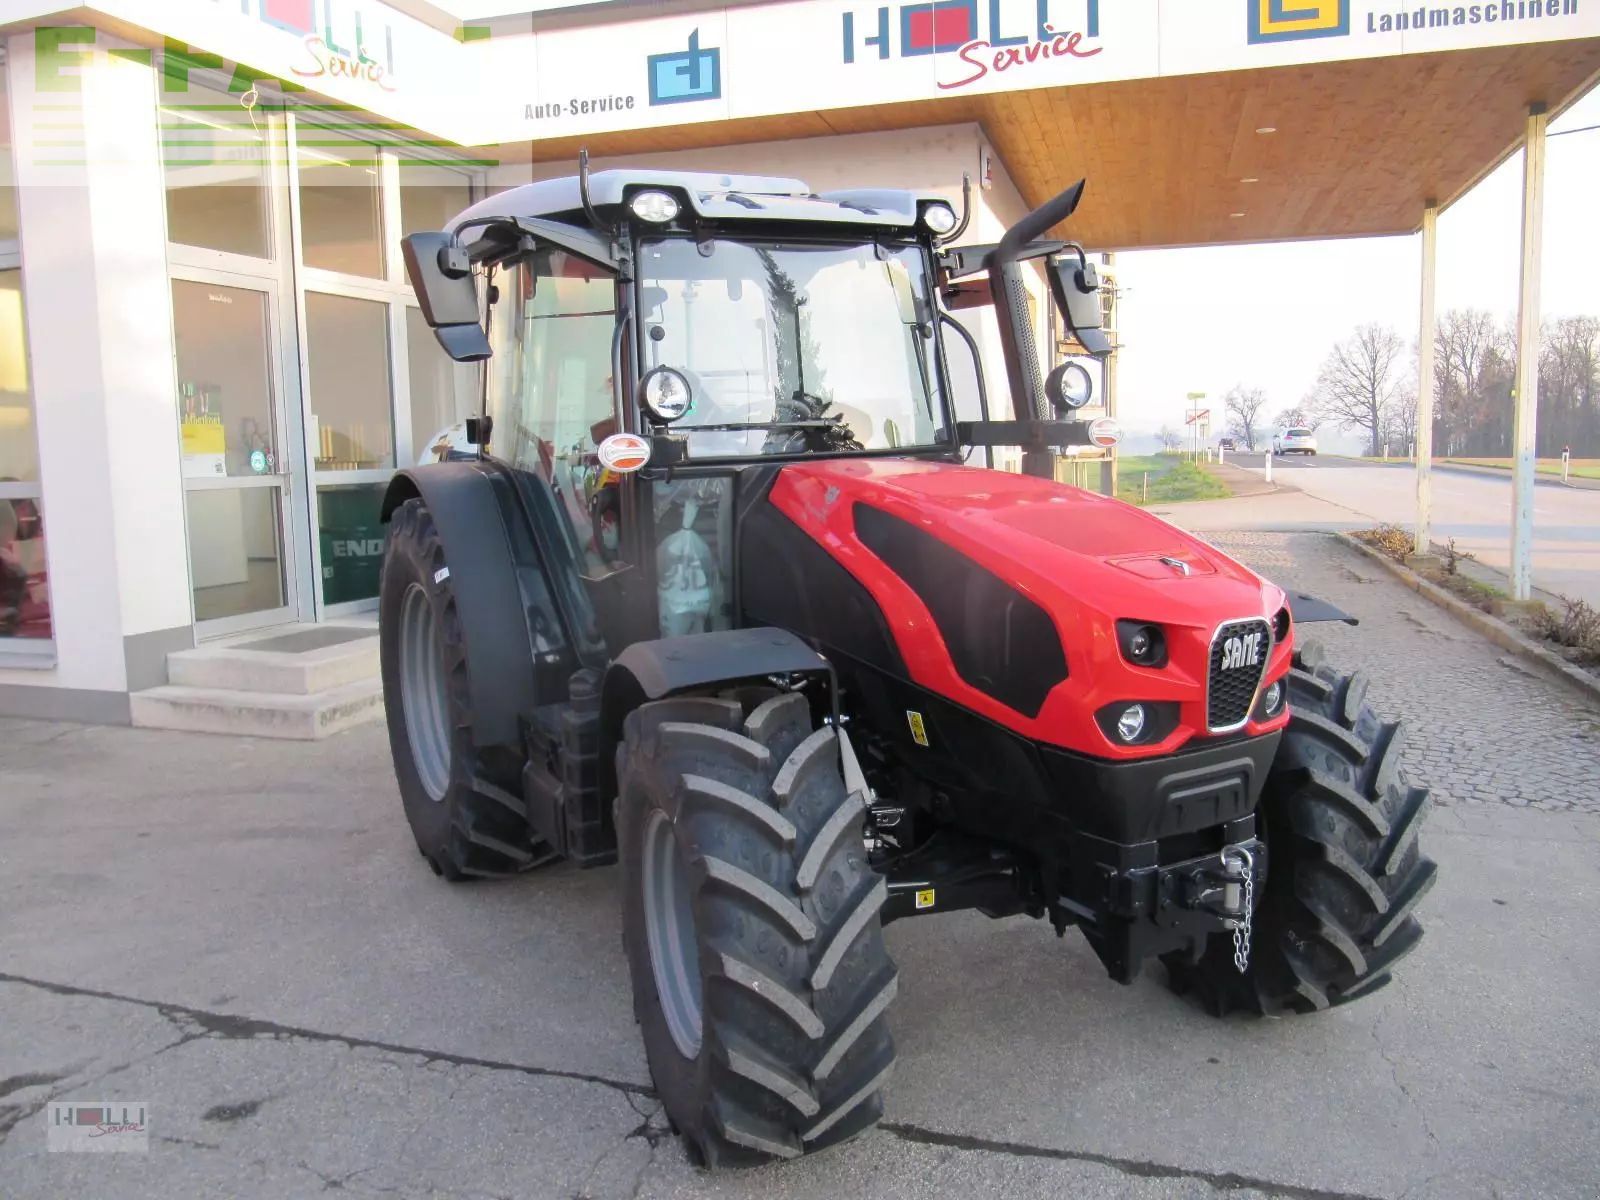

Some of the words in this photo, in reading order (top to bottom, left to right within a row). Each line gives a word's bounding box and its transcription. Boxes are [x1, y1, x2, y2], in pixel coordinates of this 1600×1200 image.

[1366, 0, 1578, 33] Landmaschinen
[290, 37, 397, 92] Service
[937, 24, 1103, 89] Service
[524, 95, 635, 119] Auto-Service
[1221, 632, 1262, 671] SAME
